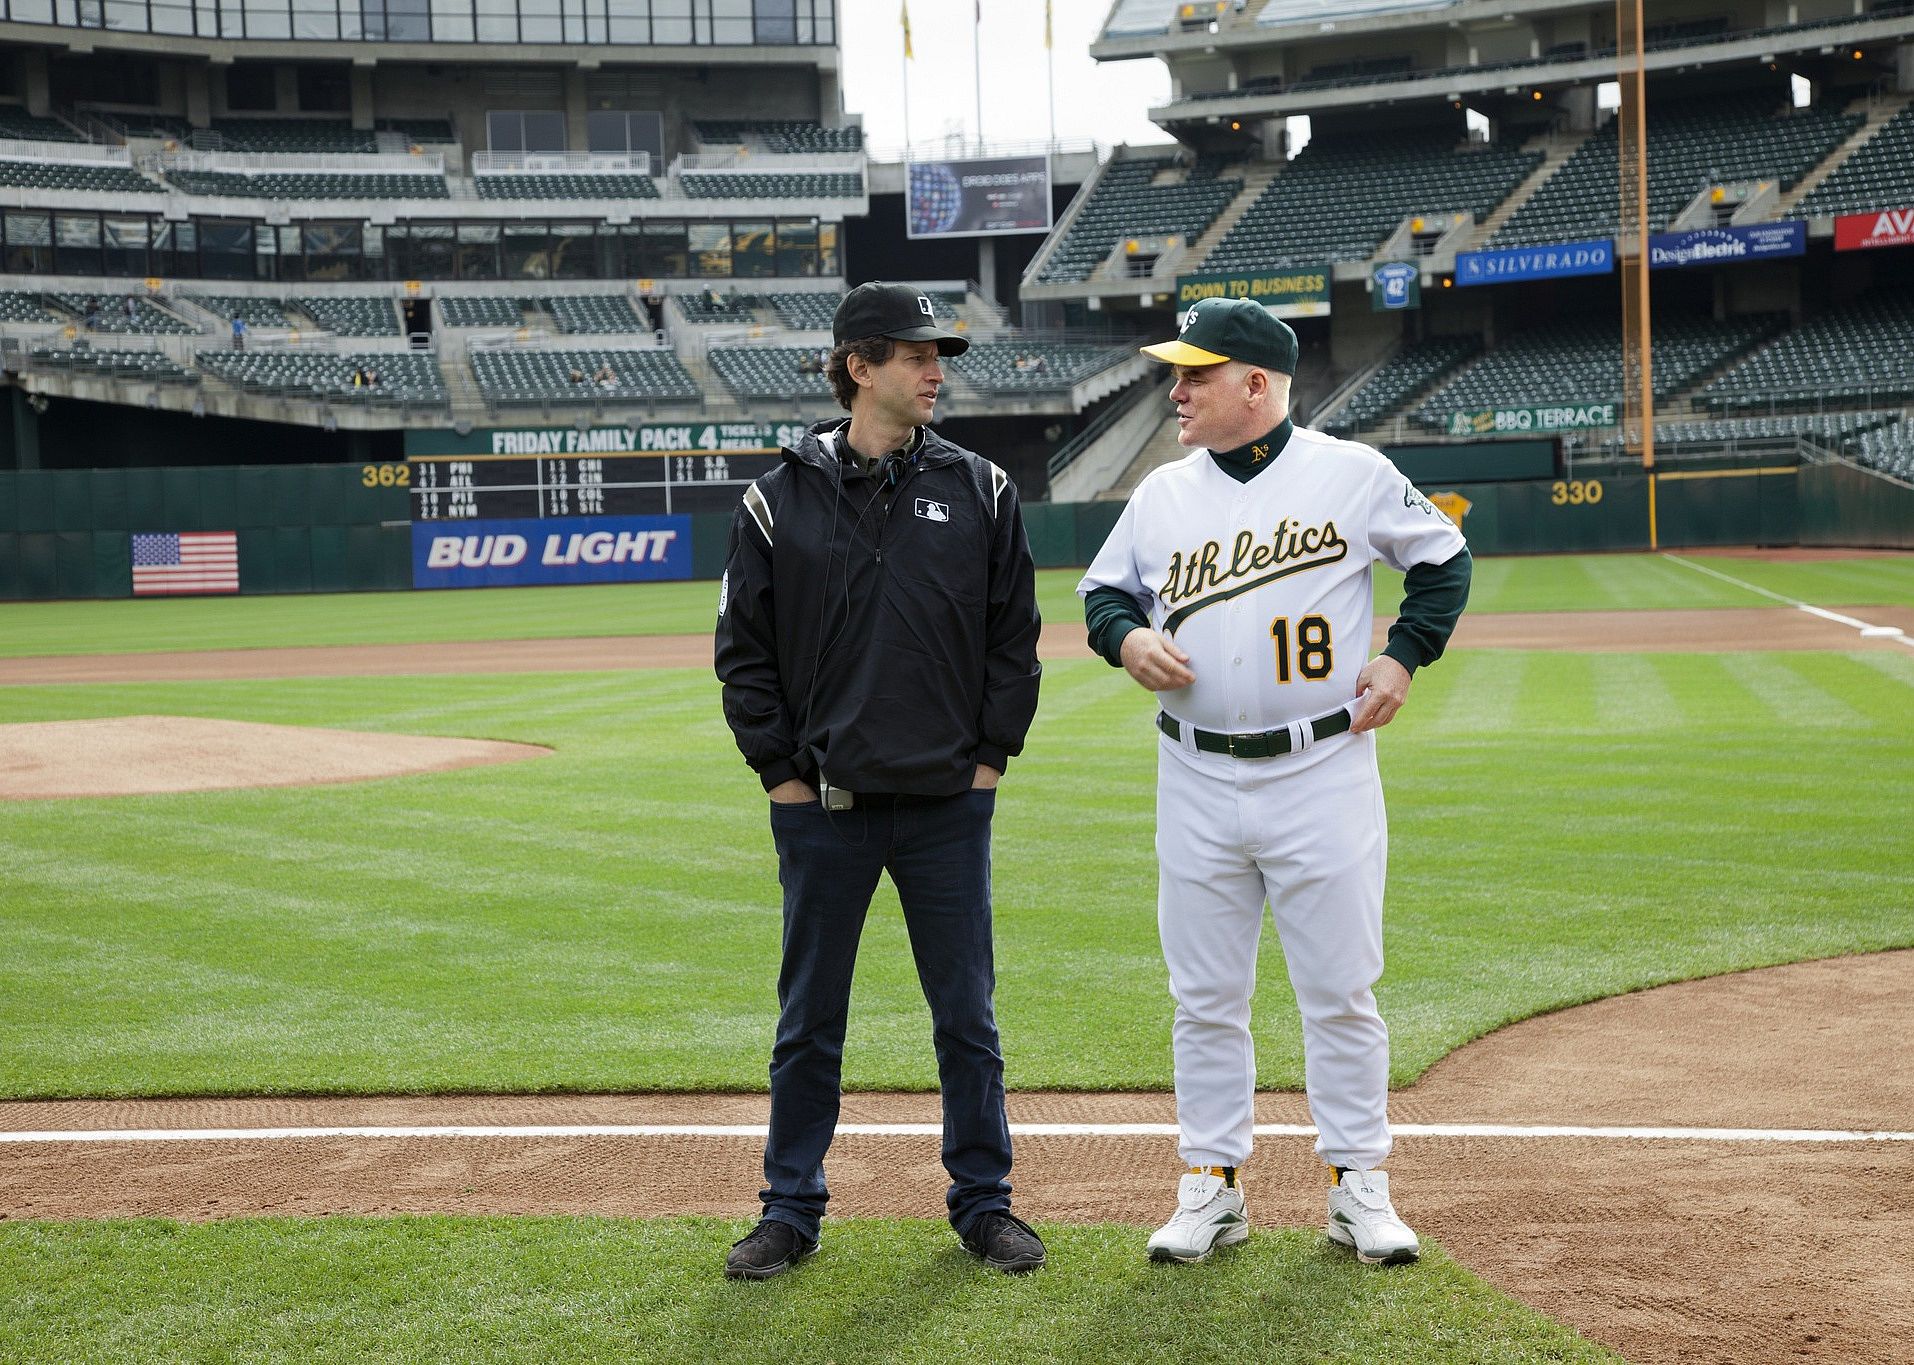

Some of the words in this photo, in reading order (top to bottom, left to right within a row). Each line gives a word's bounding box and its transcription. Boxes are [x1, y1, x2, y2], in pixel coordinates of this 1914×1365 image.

[1486, 248, 1606, 275] SILVERADO
[1652, 240, 1746, 265] DesignElectric
[1180, 281, 1226, 301] DOWN
[1229, 280, 1249, 296] TO
[1252, 275, 1324, 296] BUSINESS
[1495, 410, 1532, 430] BBQ
[1535, 404, 1614, 428] TERRACE
[492, 431, 562, 453] FRIDAY
[566, 430, 636, 452] FAMILY
[640, 427, 692, 450] PACK
[698, 425, 718, 450] 4
[720, 438, 764, 450] MEALS
[1252, 444, 1269, 464] A's
[362, 464, 410, 487] 362
[450, 462, 472, 475] PHI
[1551, 480, 1603, 505] 330
[448, 503, 477, 518] NYM
[427, 535, 527, 568] BUD
[541, 530, 676, 565] LIGHT
[1159, 514, 1348, 606] Athletics
[1270, 614, 1334, 684] 18
